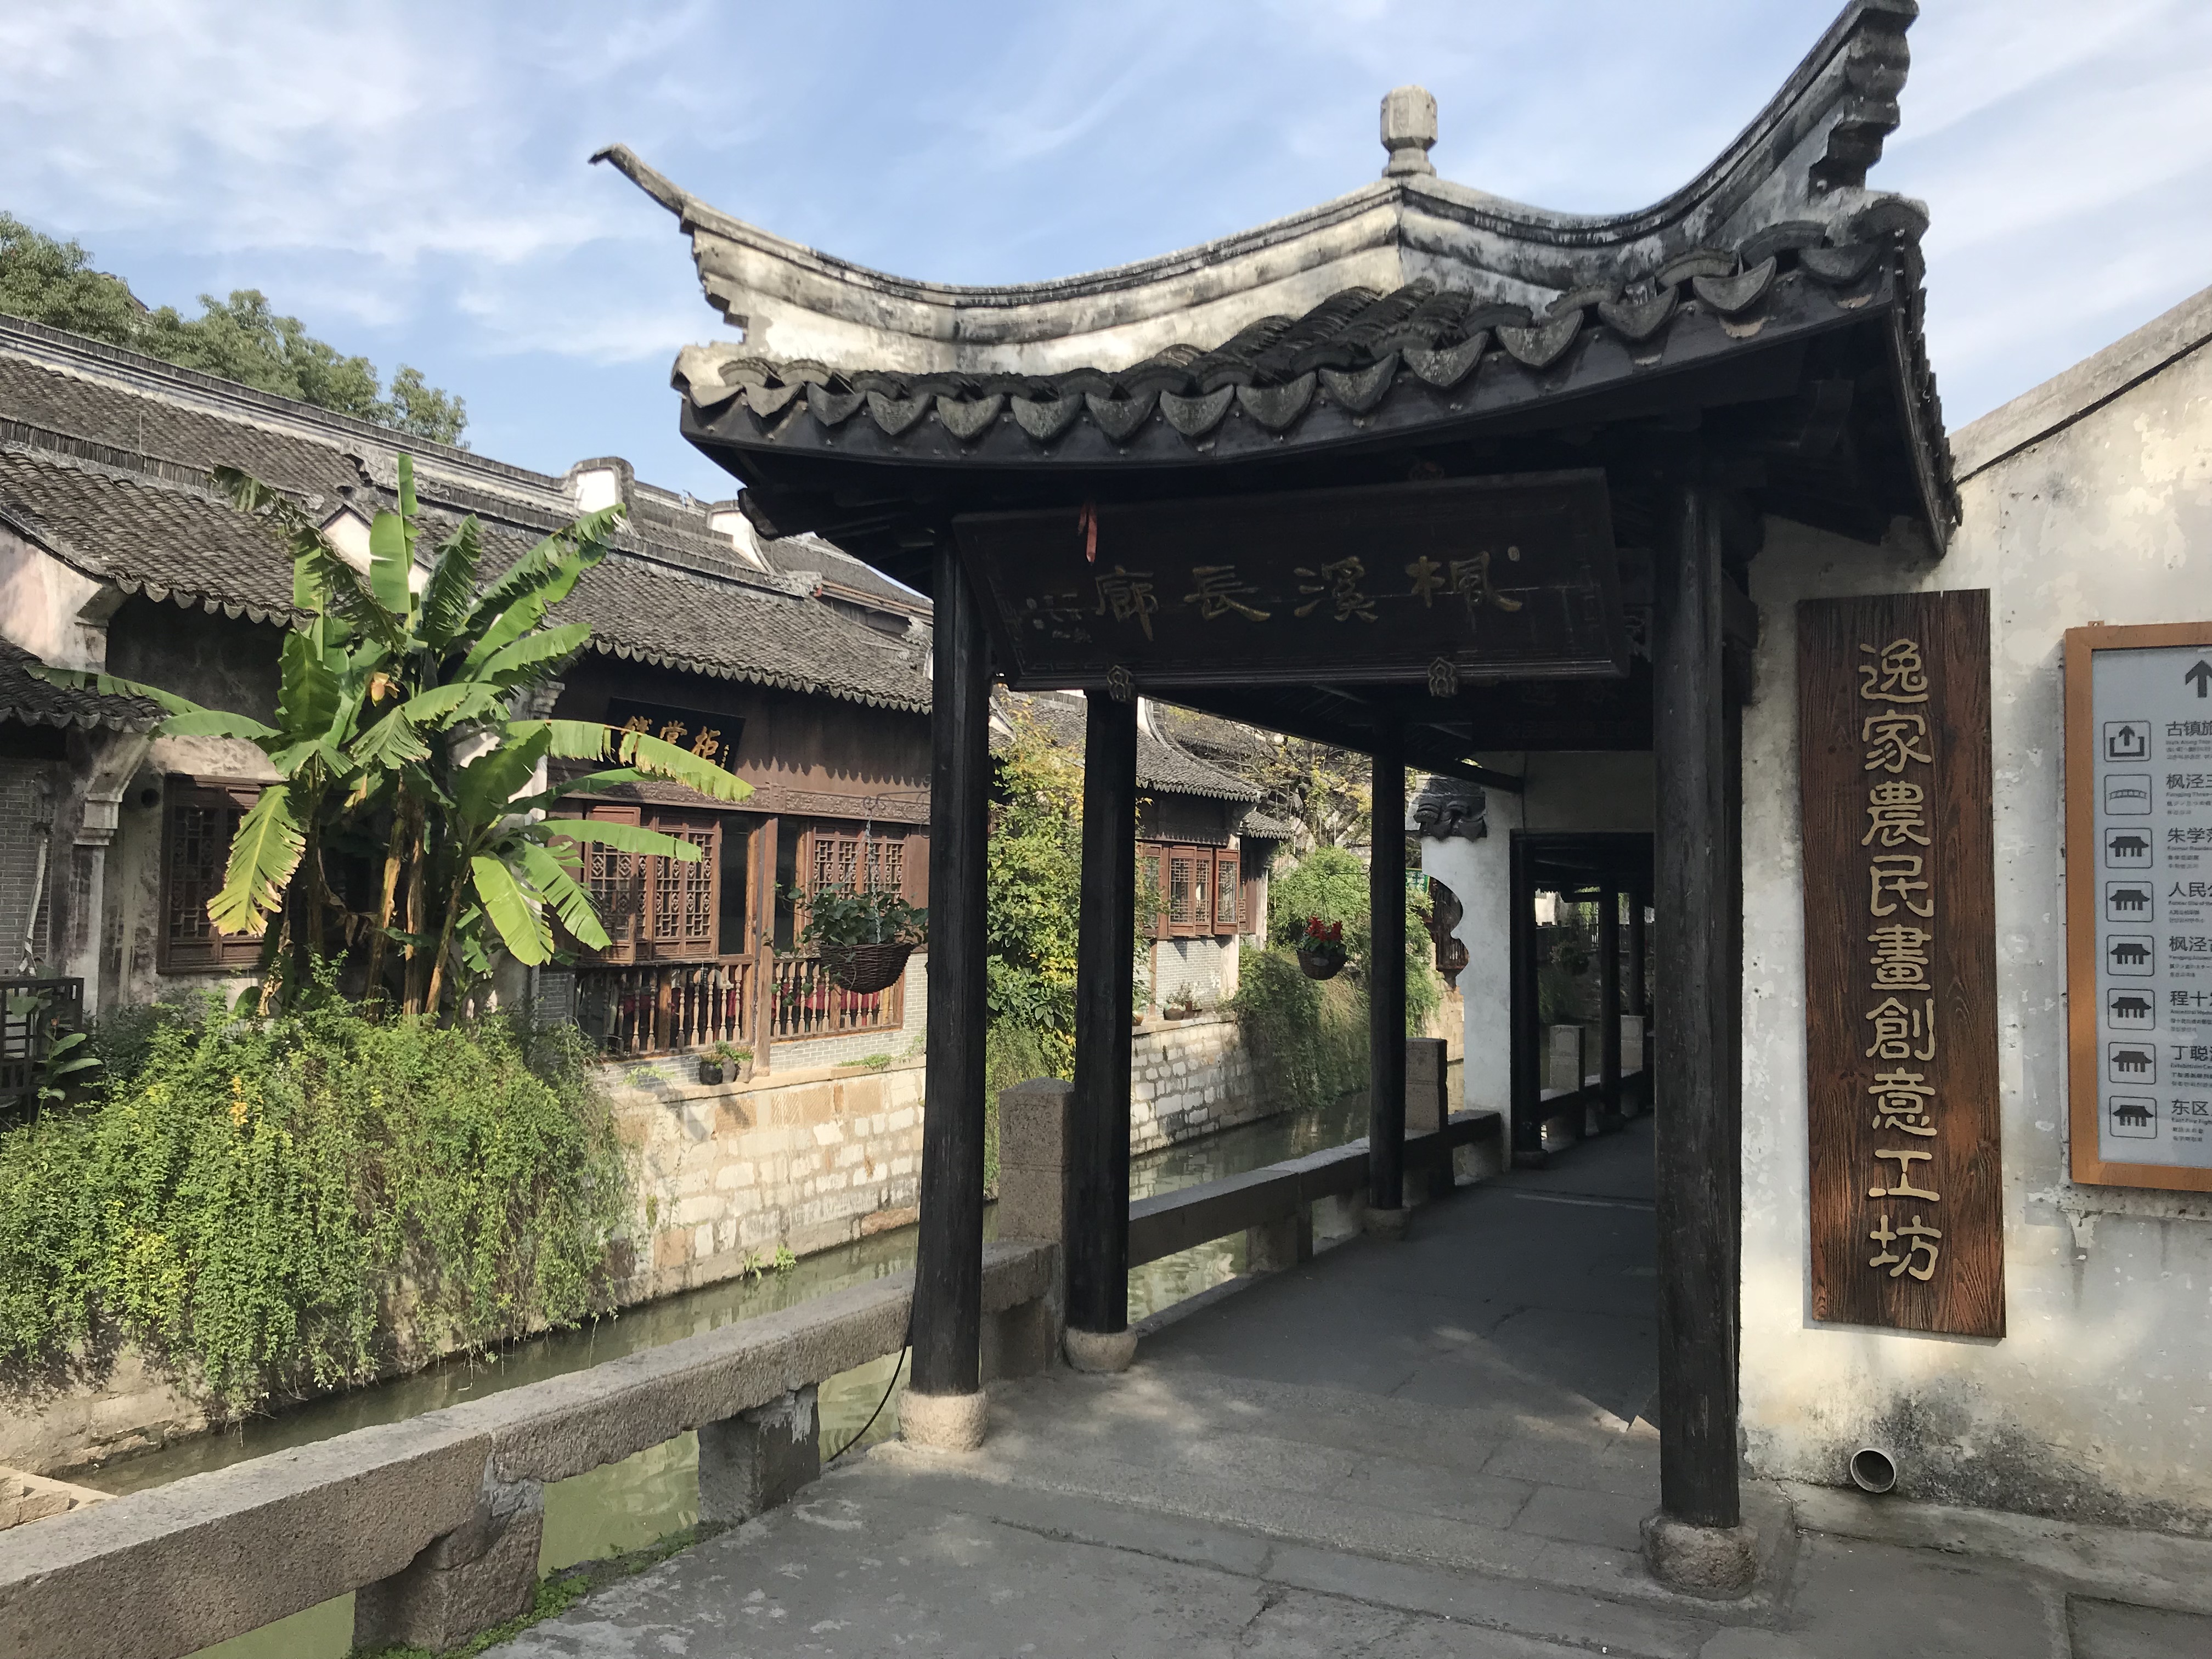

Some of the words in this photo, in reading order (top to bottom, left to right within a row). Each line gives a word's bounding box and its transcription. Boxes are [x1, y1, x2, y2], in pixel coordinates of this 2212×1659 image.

[2168, 881, 2212, 897] 人民
[2169, 935, 2212, 952] 枫泾
[1859, 637, 1943, 1279] 逸家農民畫創意工坊
[2170, 991, 2212, 1007] 程十
[2170, 1045, 2212, 1061] 丁聪
[2171, 1099, 2212, 1116] 东区
